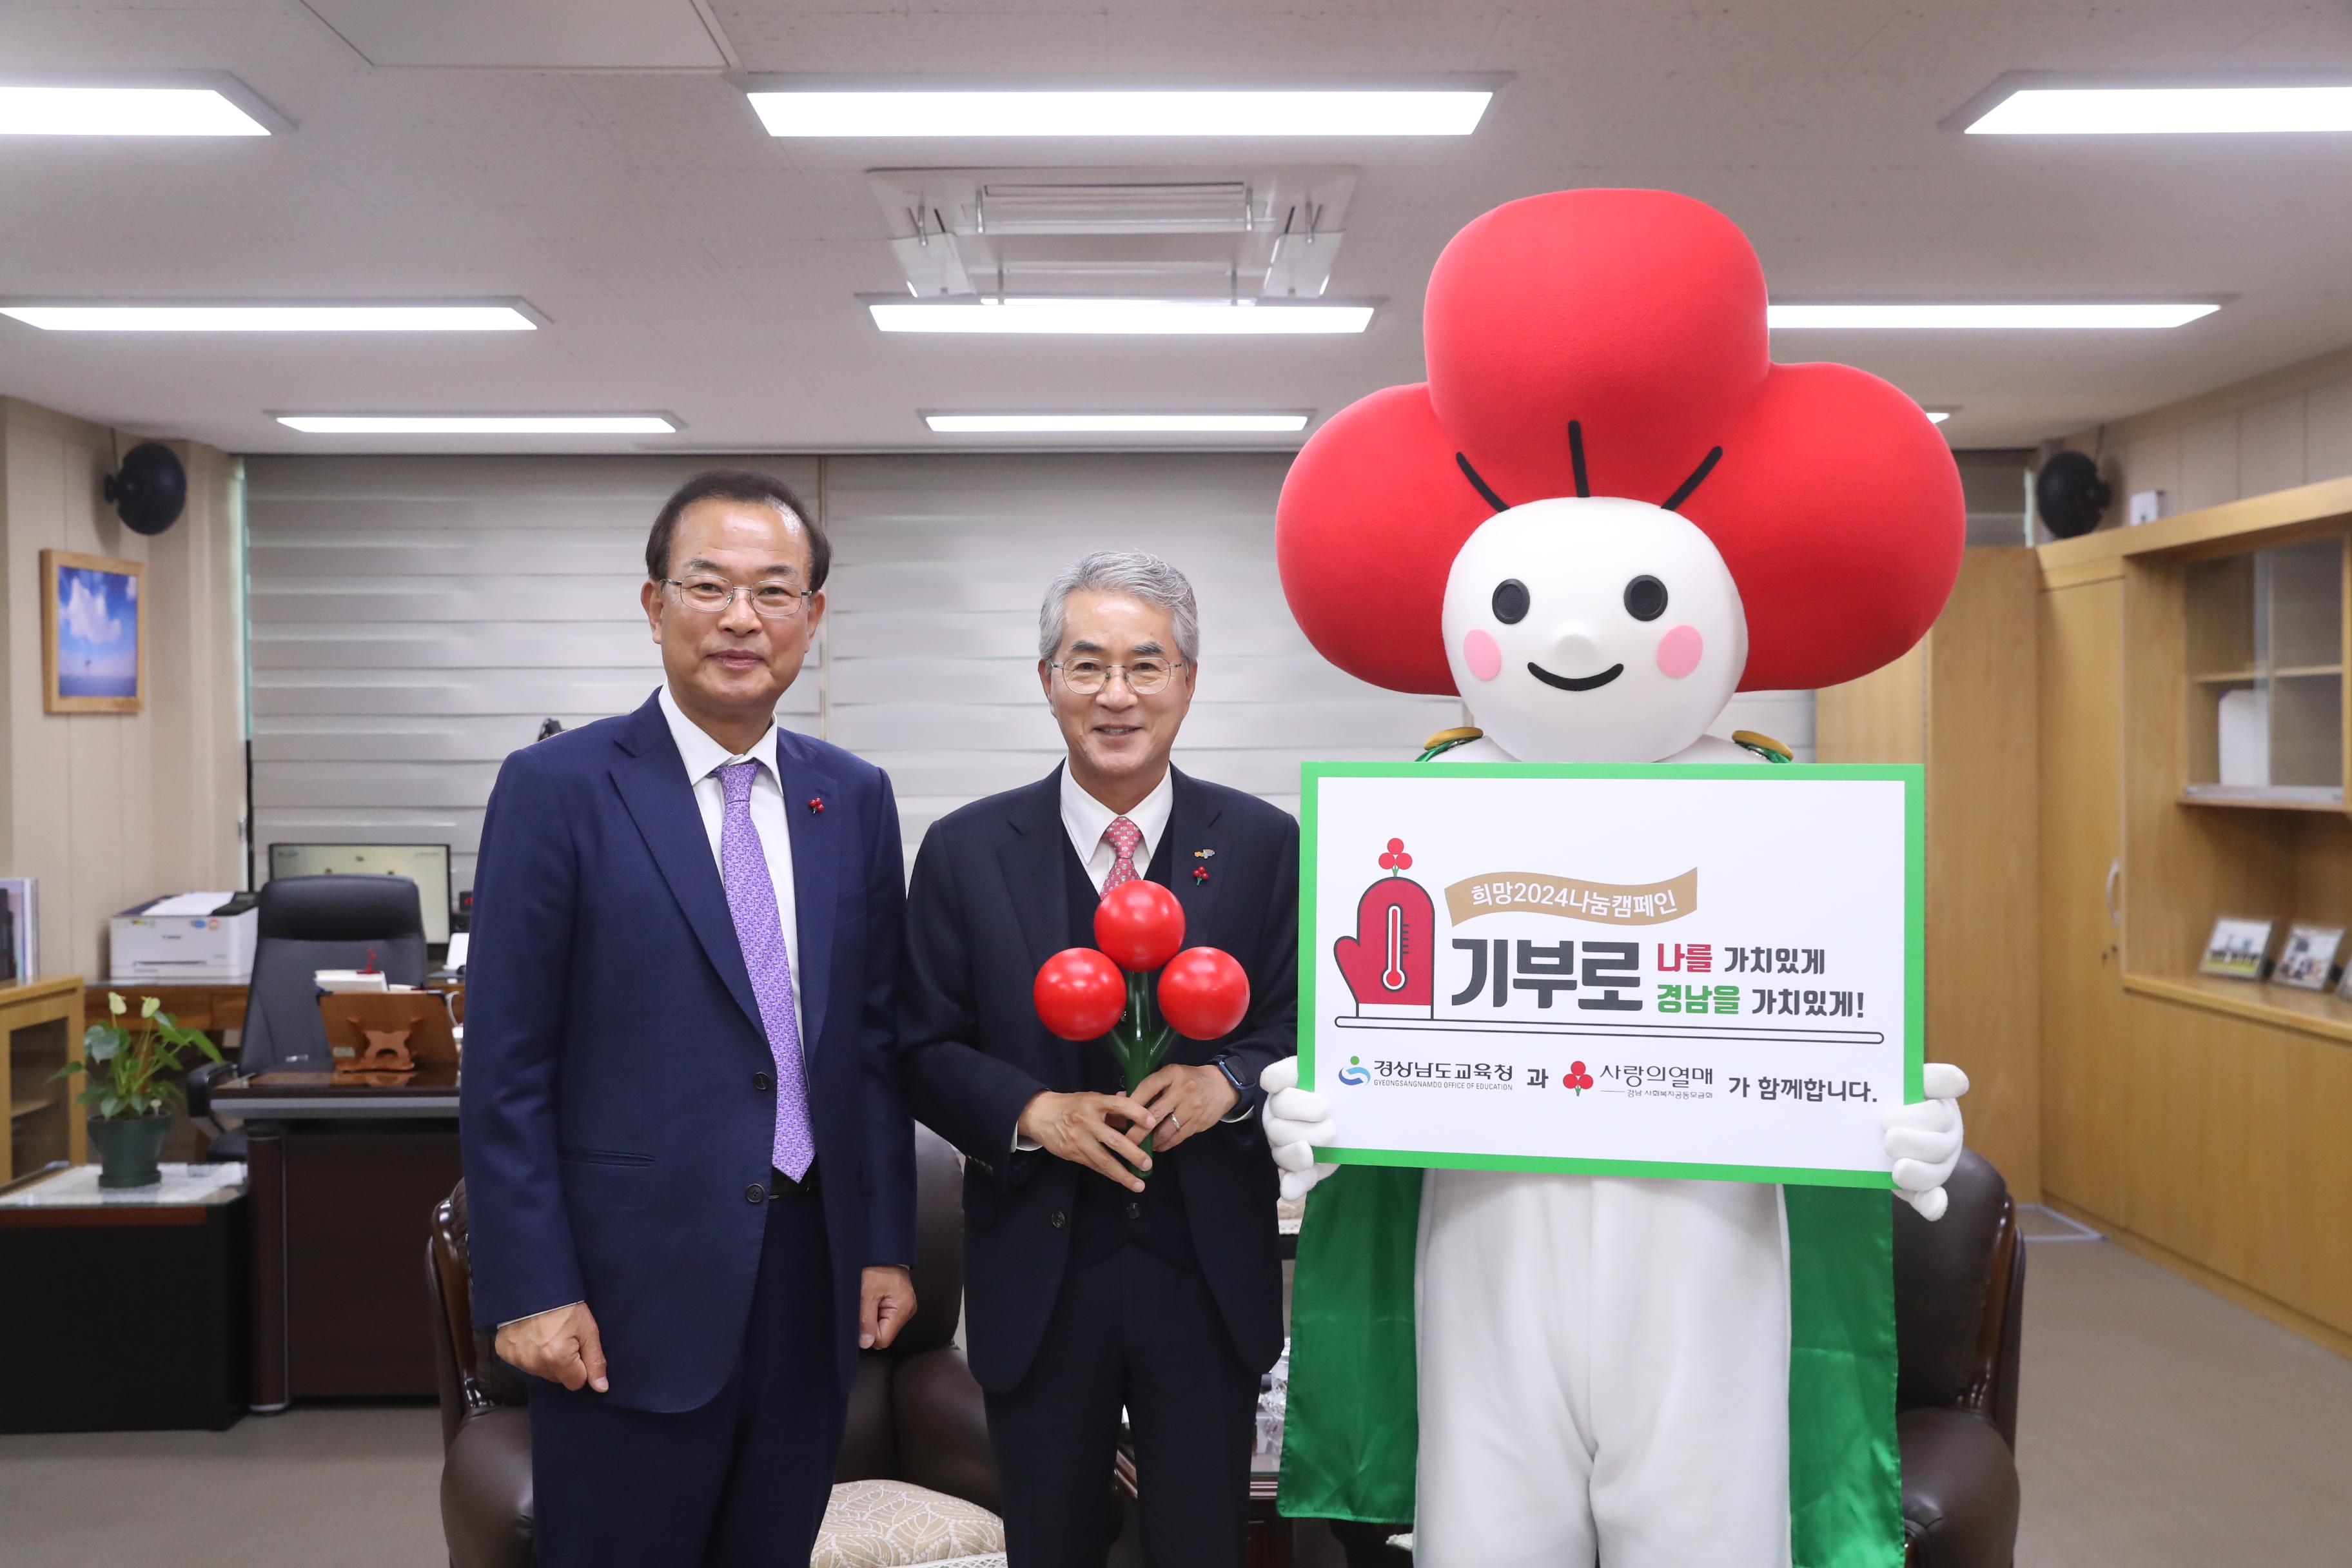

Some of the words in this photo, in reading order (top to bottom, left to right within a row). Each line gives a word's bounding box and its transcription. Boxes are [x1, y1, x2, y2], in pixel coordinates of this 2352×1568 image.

[1471, 881, 1678, 918] 희망2024나눔캠페인
[1658, 943, 1712, 972] 나를
[1725, 946, 1825, 974] 가치있게
[1452, 939, 1643, 1011] 기부로
[1658, 985, 1740, 1014] 경남을
[1752, 988, 1864, 1018] 가치있게!
[1374, 1061, 1513, 1081] 경상남도교육청
[1527, 1068, 1549, 1088] 과
[1600, 1065, 1712, 1088] 사랑의열매
[1374, 1079, 1442, 1088] GYEONGSANGNAMDO
[1644, 1090, 1712, 1099] 사회복지공동모금회
[1729, 1077, 1750, 1097] 가
[1758, 1077, 1877, 1102] 함께합니다.
